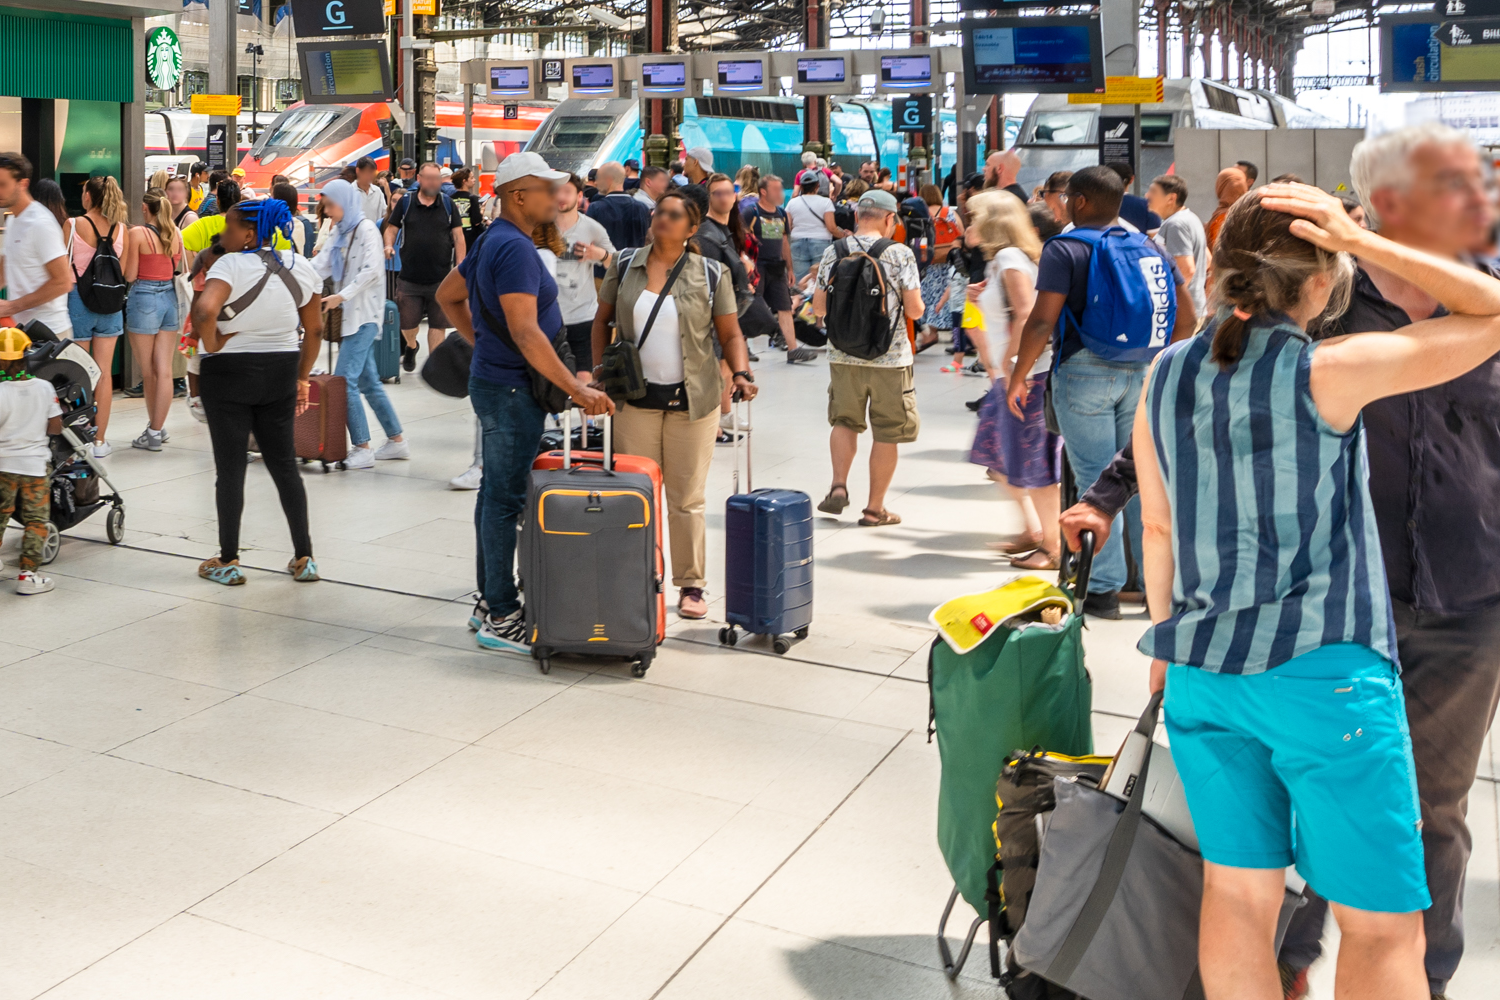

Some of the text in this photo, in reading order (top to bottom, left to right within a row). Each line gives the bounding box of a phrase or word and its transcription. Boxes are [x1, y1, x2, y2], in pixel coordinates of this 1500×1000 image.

[325, 0, 346, 25] G
[326, 52, 336, 96] circulation
[903, 108, 920, 124] G
[1150, 264, 1168, 340] adidas
